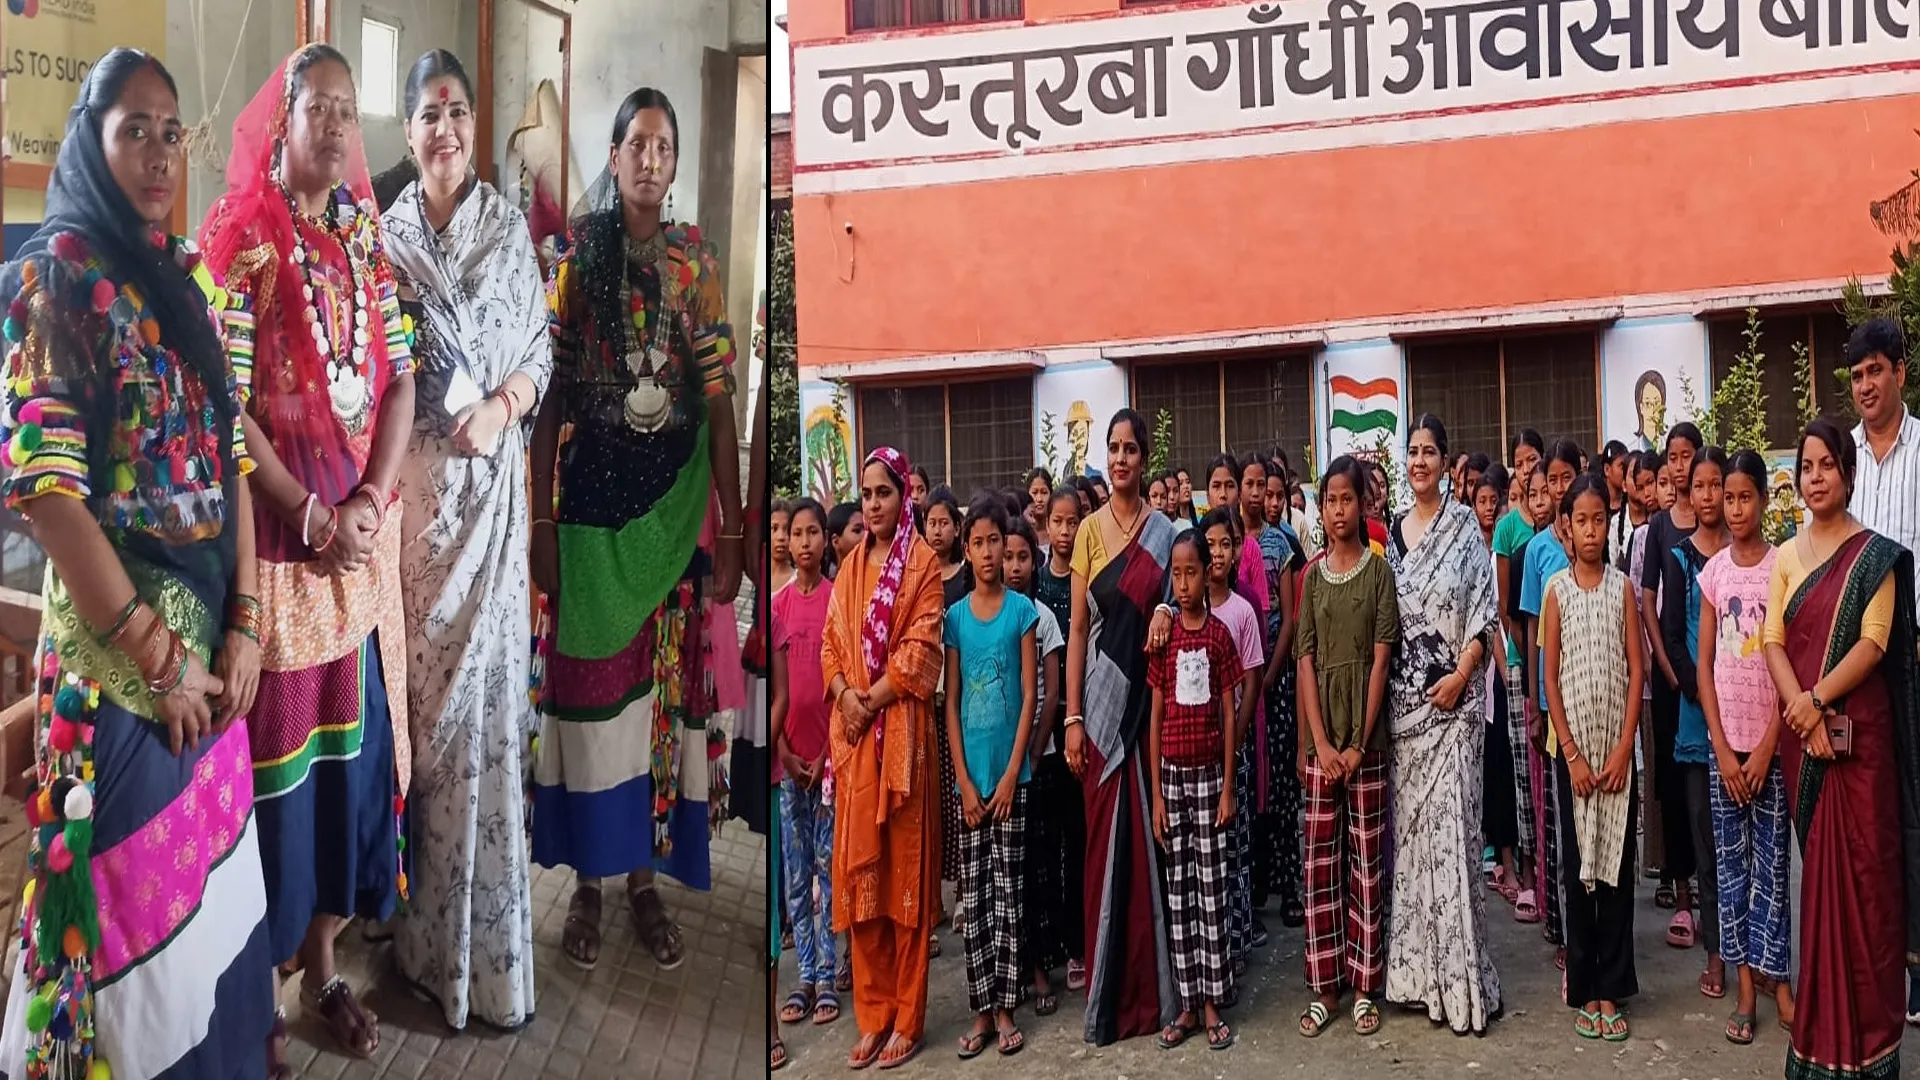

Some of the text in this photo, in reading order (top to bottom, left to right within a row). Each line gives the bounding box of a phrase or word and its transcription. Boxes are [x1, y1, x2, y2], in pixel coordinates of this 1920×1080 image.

[29, 51, 51, 78] TO
[56, 56, 94, 82] SUC
[818, 36, 1173, 149] कस्तूरबा
[1186, 0, 1374, 109] गाँधी
